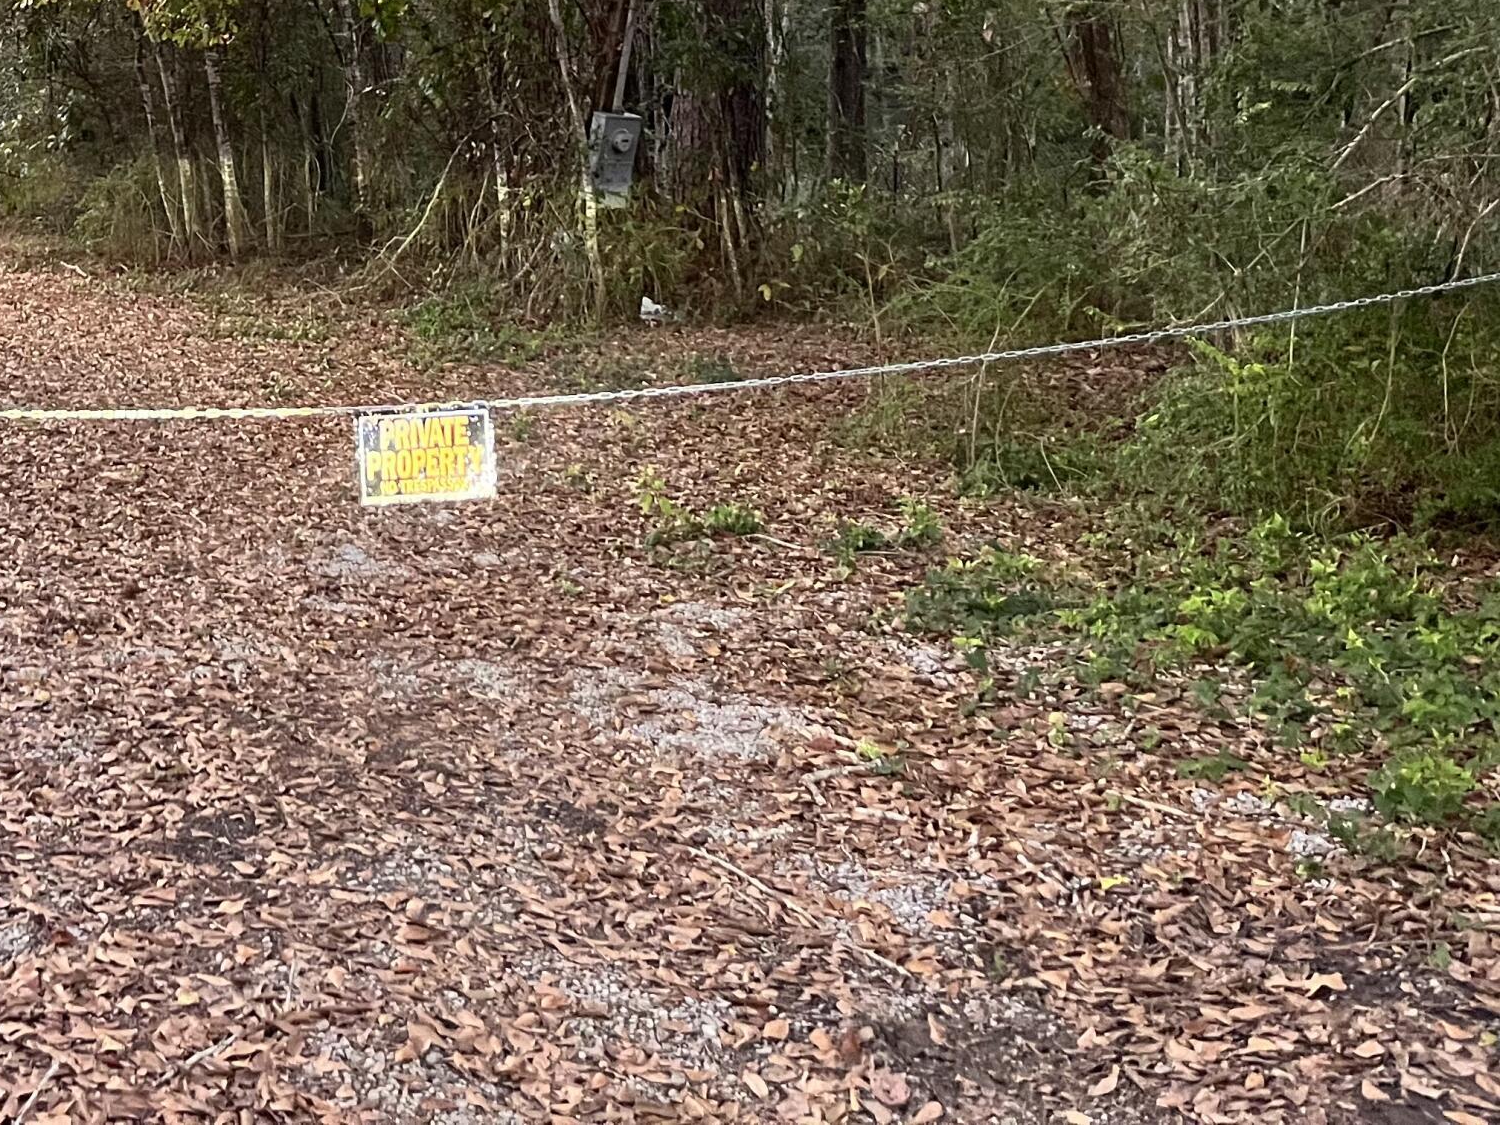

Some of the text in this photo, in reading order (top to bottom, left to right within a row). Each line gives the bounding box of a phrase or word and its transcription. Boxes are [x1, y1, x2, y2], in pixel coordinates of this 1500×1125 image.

[379, 416, 469, 450] PRIVATE
[366, 444, 484, 481] PROPERTY
[380, 480, 398, 495] NO
